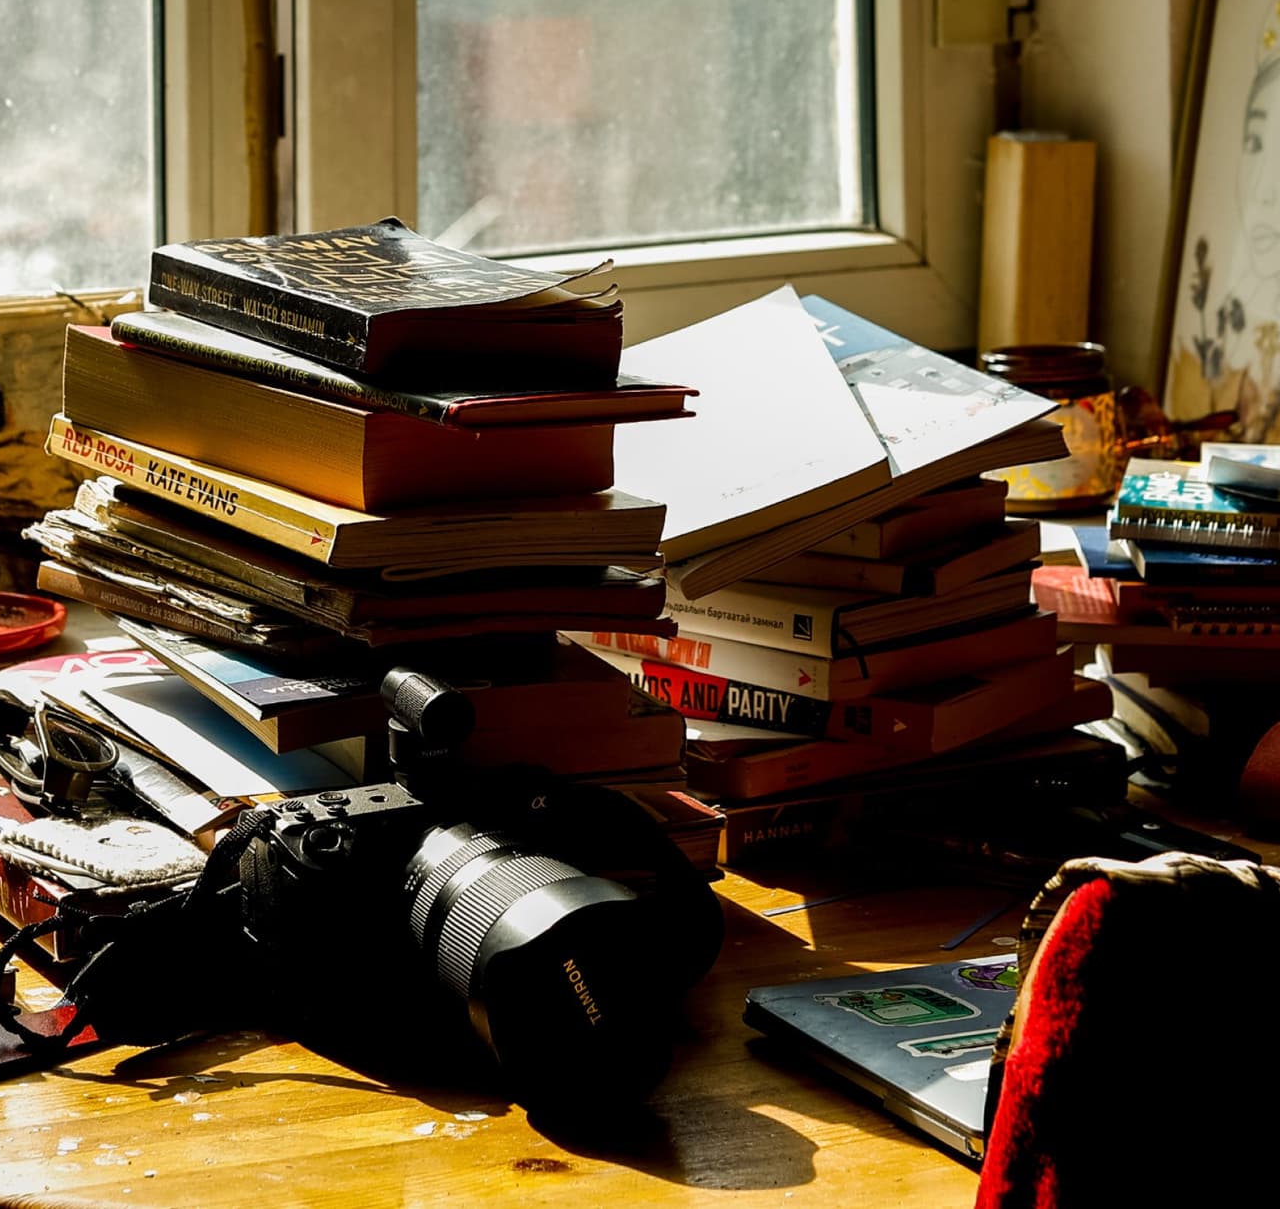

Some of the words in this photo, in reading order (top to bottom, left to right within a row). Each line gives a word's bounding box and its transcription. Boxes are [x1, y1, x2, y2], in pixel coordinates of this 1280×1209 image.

[160, 272, 200, 301] ONE-WAY
[201, 283, 234, 311] STREET
[242, 295, 279, 323] WALTER
[280, 310, 328, 337] BENJAMIN
[117, 324, 137, 341] THE
[136, 328, 218, 363] CHOREOGRAPHY
[220, 350, 235, 367] OF
[236, 353, 288, 380] EVERYDAY
[289, 368, 309, 384] LIFE
[362, 387, 409, 412] PARSON
[62, 428, 93, 459] RED
[94, 438, 136, 477] ROSA
[145, 459, 186, 497] KATE
[186, 476, 240, 517] EVANS
[679, 680, 720, 714] AND
[727, 686, 791, 724] PARTY
[562, 958, 603, 1027] TAMRON
